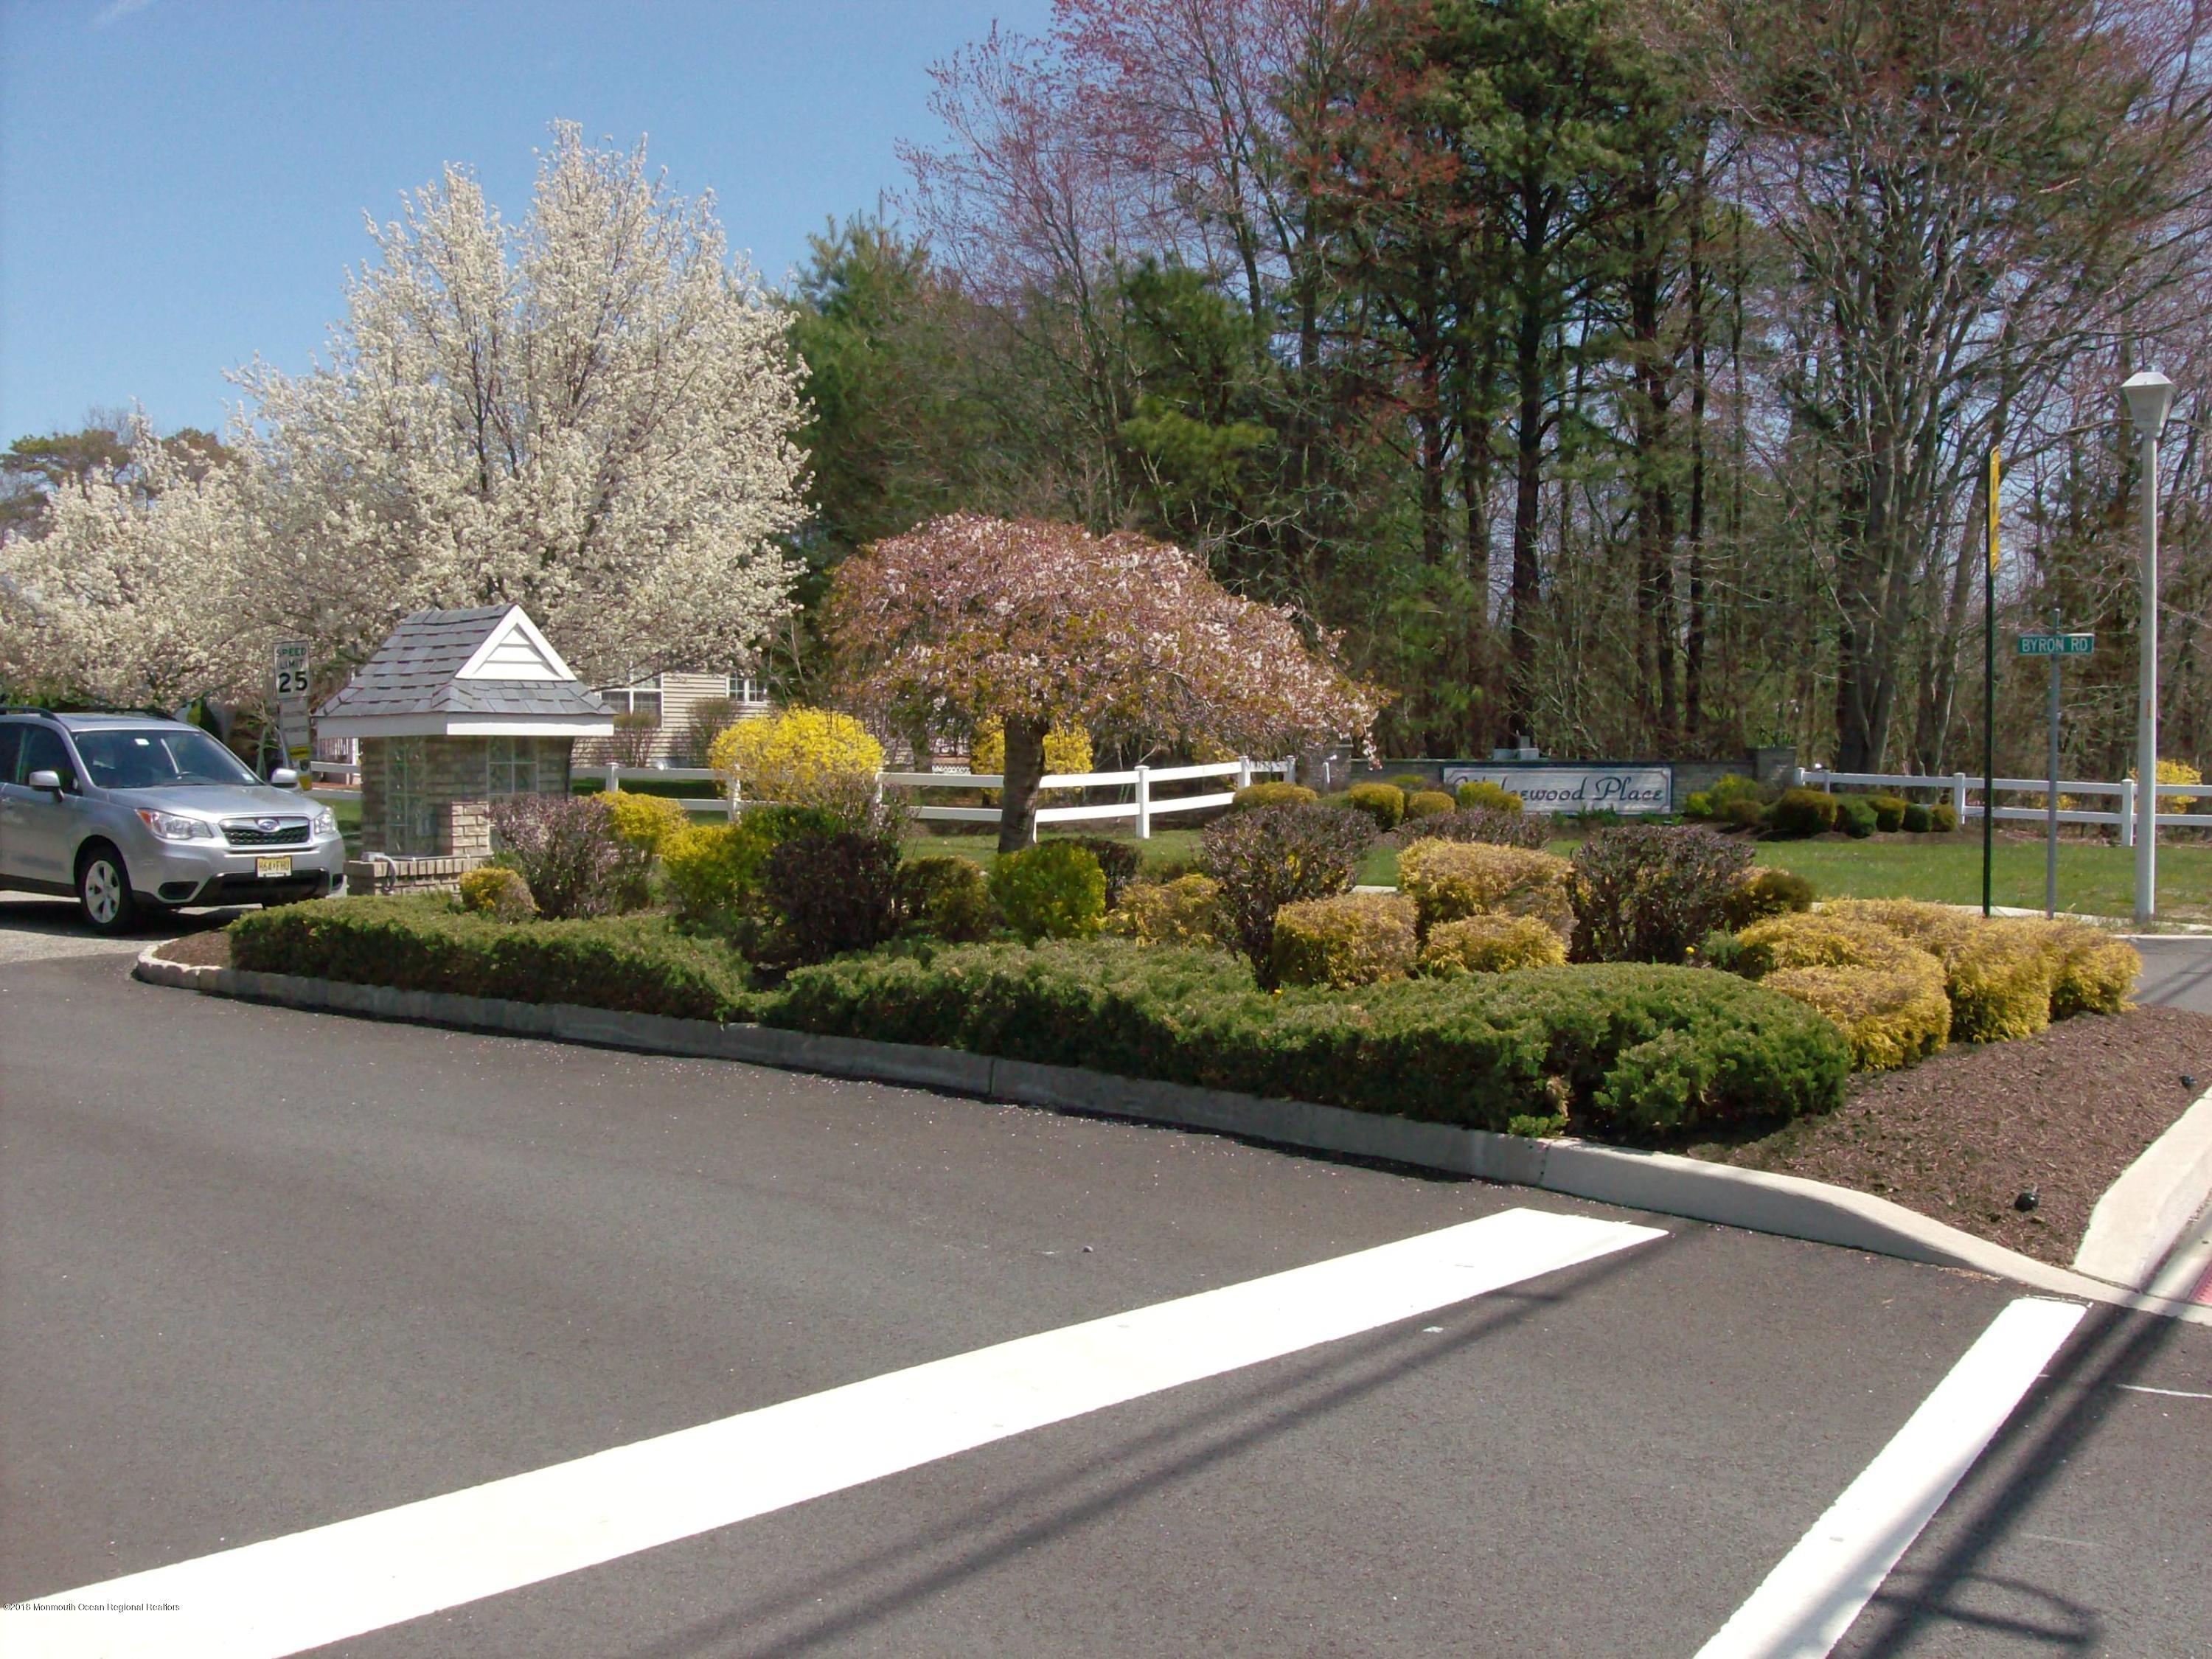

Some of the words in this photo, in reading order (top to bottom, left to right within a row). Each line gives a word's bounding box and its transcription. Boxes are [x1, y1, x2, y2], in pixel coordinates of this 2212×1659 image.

[276, 647, 307, 658] SPEED
[2022, 638, 2065, 653] BYRON
[2070, 637, 2088, 651] RD
[280, 658, 304, 669] LIMIT
[279, 671, 307, 693] 25
[1595, 776, 1663, 801] Place
